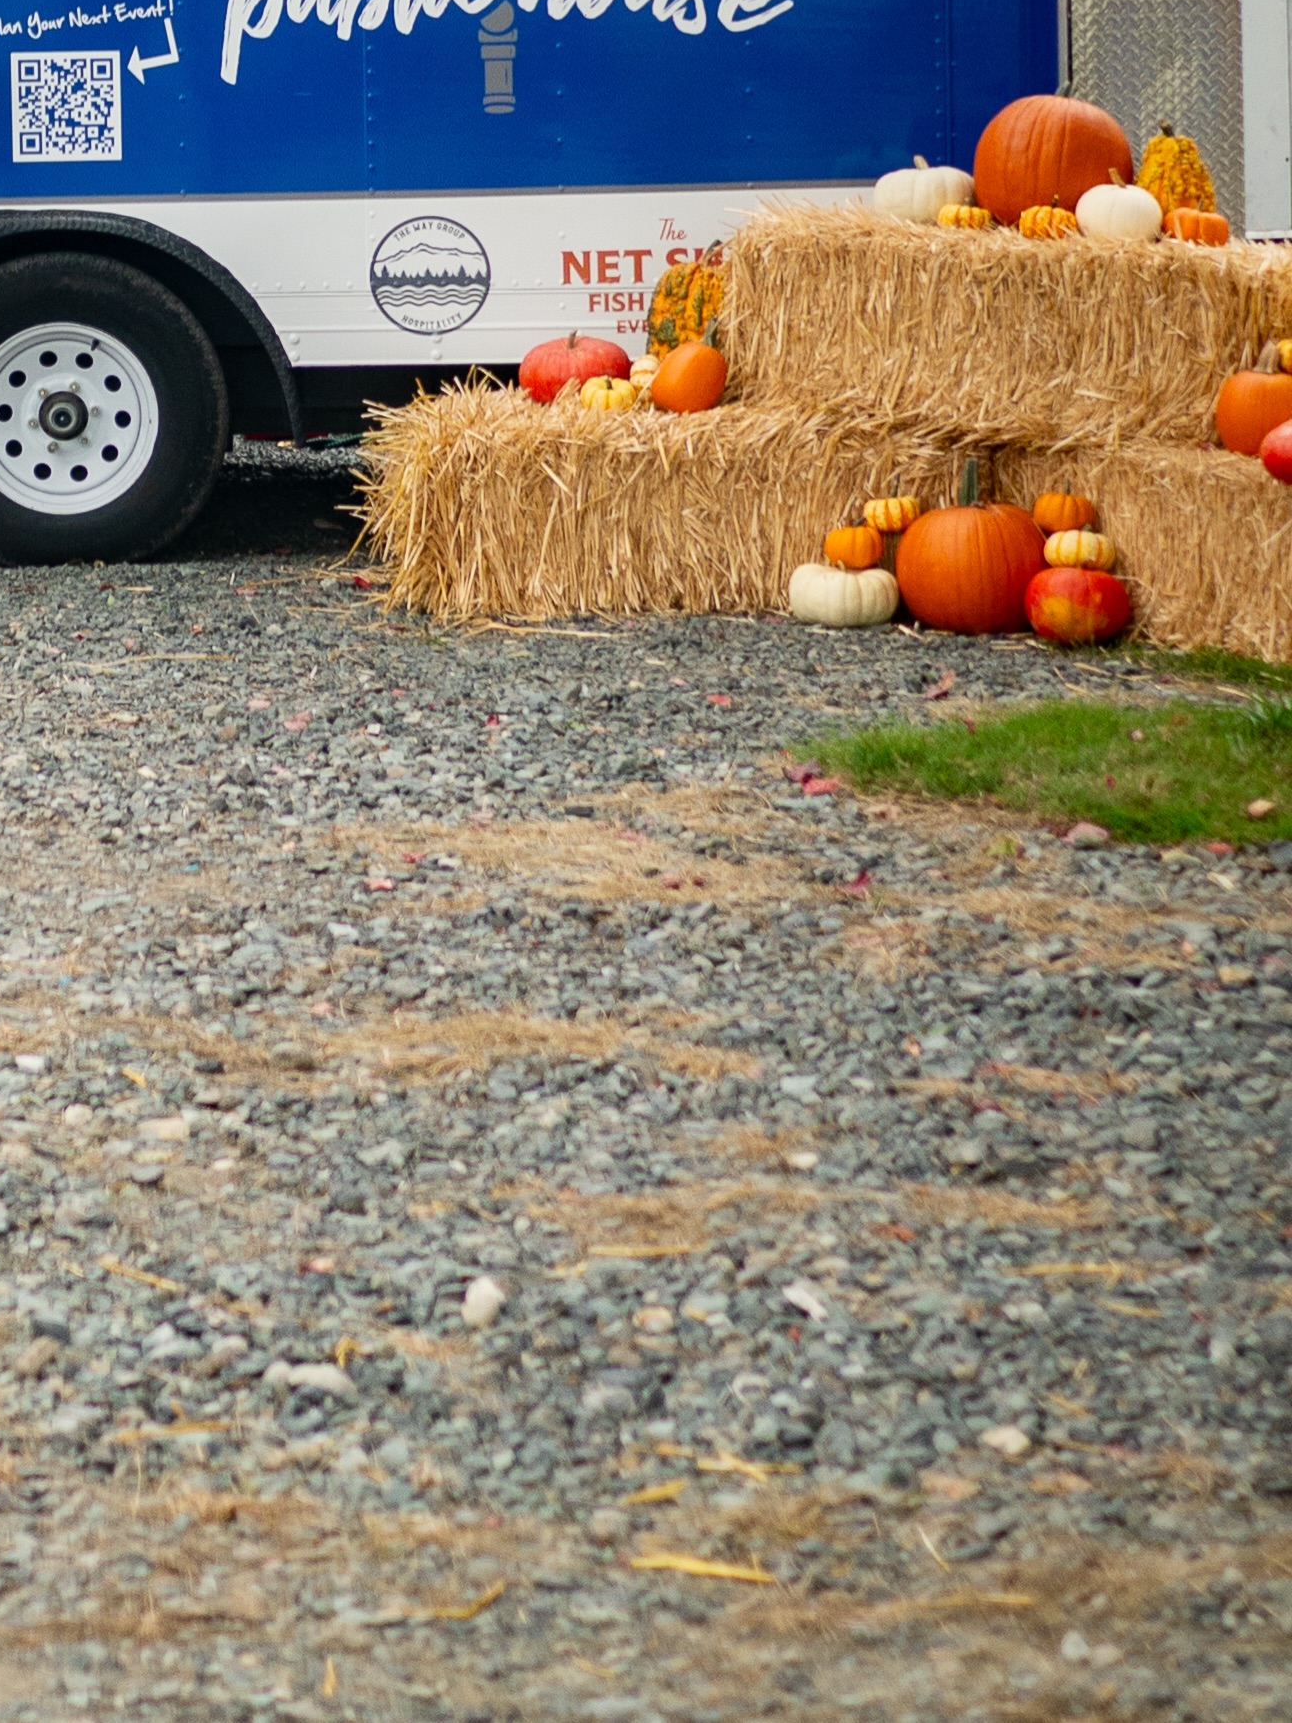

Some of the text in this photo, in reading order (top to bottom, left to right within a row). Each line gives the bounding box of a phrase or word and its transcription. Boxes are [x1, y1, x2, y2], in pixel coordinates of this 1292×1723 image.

[27, 11, 66, 40] Your
[68, 5, 112, 28] Next
[393, 221, 466, 242] THE WAY GROUP
[659, 217, 688, 241] The
[560, 248, 653, 285] NET
[588, 292, 645, 313] FISH
[401, 311, 463, 331] HOSPITALITY
